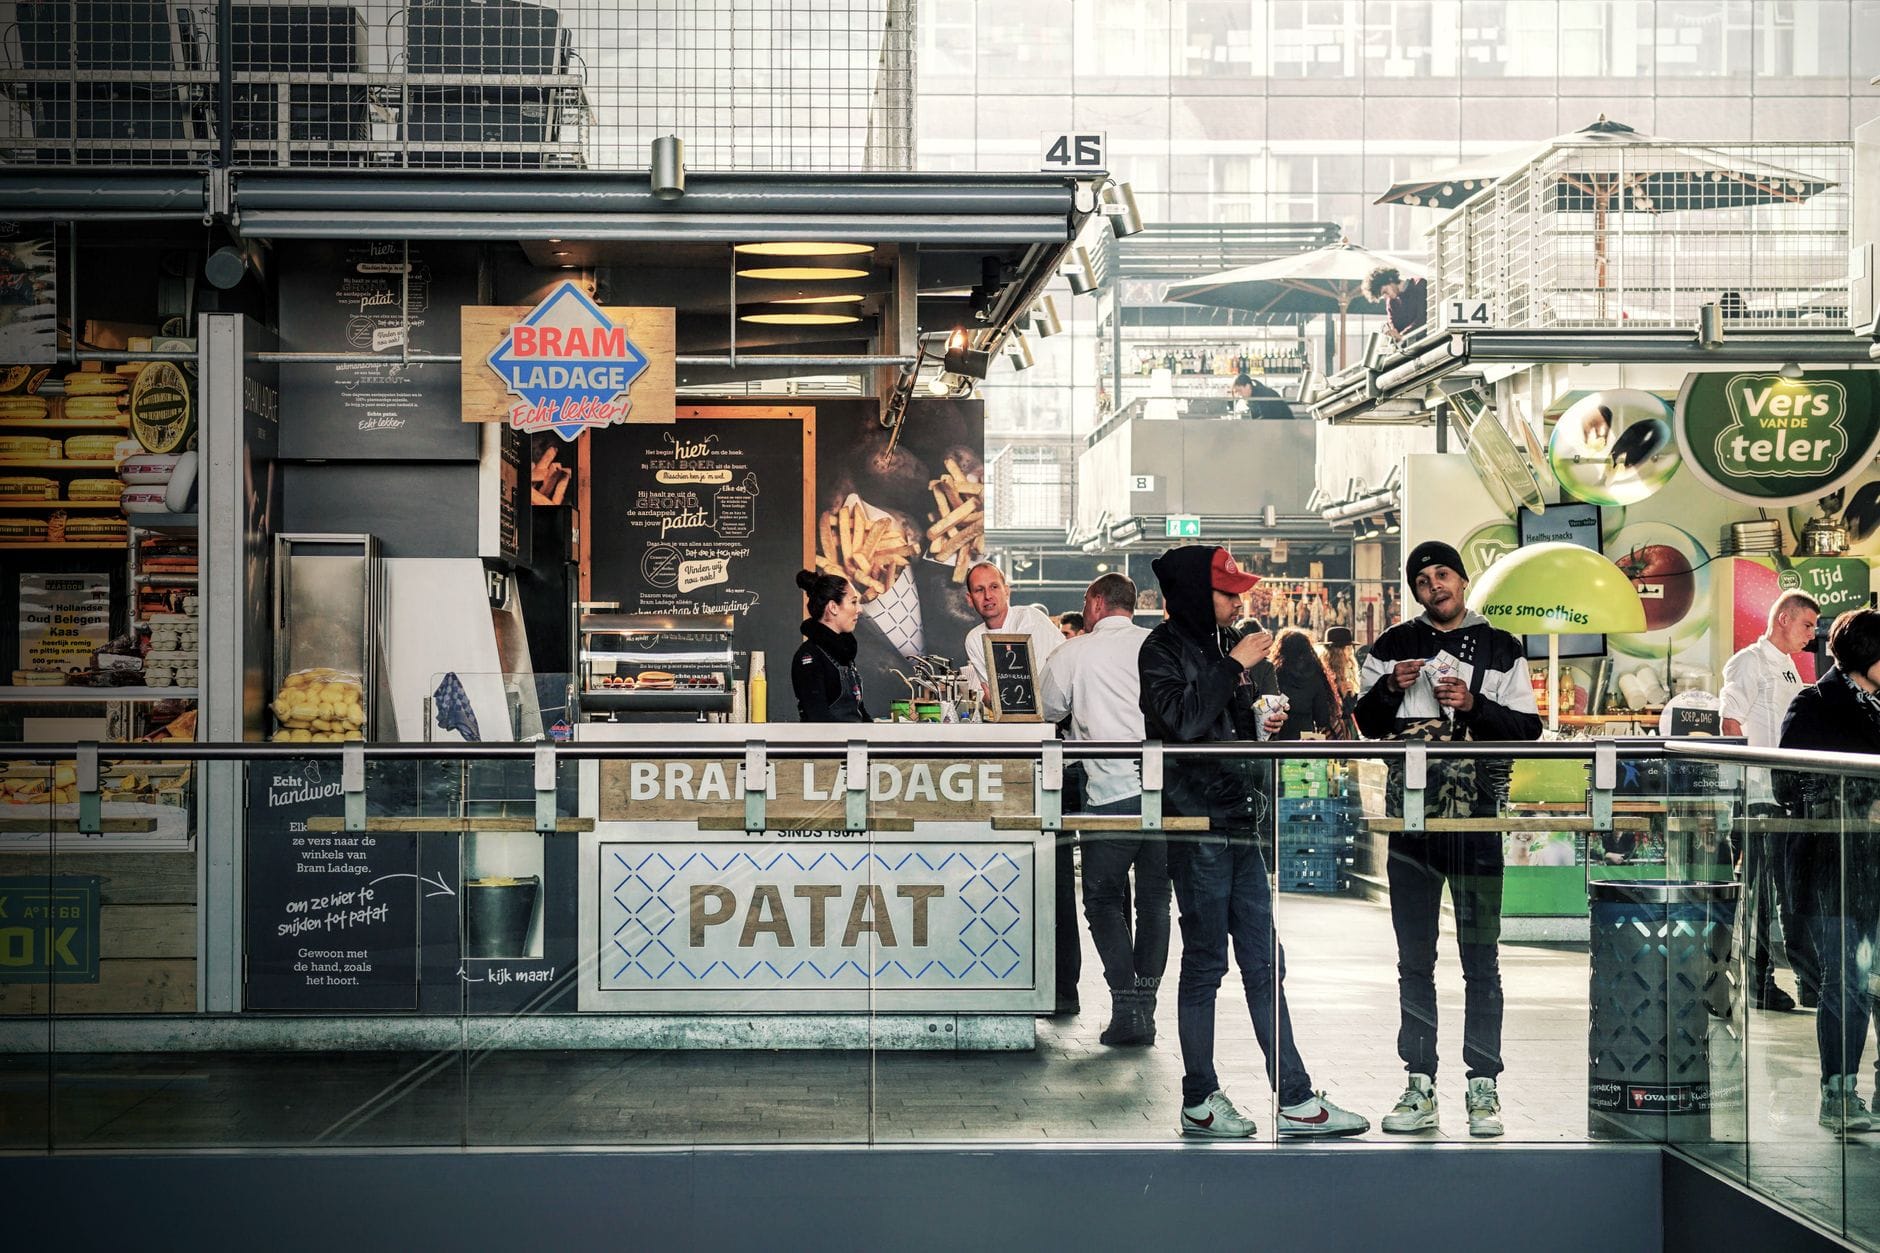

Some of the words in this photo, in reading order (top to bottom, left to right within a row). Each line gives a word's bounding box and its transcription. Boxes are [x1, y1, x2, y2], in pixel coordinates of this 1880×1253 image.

[1046, 135, 1101, 165] 46
[370, 241, 397, 256] hier
[360, 289, 395, 313] patat
[1450, 302, 1489, 324] 14
[513, 327, 626, 358] BRAM
[512, 366, 625, 390] LADAGE
[1743, 387, 1830, 417] Vers
[511, 396, 561, 427] Echt
[560, 395, 629, 422] lekker!
[358, 418, 377, 430] Echt
[378, 417, 406, 428] lekker!
[1759, 418, 1789, 429] VAN
[1790, 418, 1808, 428] DE
[674, 440, 710, 460] hier
[1730, 429, 1831, 463] teler
[649, 460, 675, 470] EEN
[679, 460, 715, 470] BOER
[635, 496, 700, 509] GROND
[638, 491, 648, 499] Hij
[638, 509, 676, 517] aardappels
[644, 519, 661, 528] jouw
[661, 506, 709, 539] patat
[1526, 533, 1551, 542] Healthy
[1551, 532, 1573, 541] snacks
[684, 563, 711, 575] Vinden
[700, 571, 716, 582] ook!
[1808, 564, 1843, 590] Tijd
[702, 600, 750, 616] toewijding
[1516, 604, 1589, 625] smoothies
[27, 615, 51, 624] Oud
[54, 615, 102, 625] Belegen
[50, 627, 79, 636] Kaas
[1005, 651, 1024, 670] 2
[1681, 710, 1697, 722] SOEP
[1700, 712, 1713, 724] DAG
[272, 776, 302, 787] Echt
[268, 775, 345, 807] handwer
[292, 838, 305, 846] ze
[307, 838, 331, 846] vers
[334, 838, 359, 846] naar
[361, 836, 376, 846] de
[301, 850, 344, 860] winkels
[346, 851, 367, 860] van
[297, 863, 326, 873] Bram
[327, 863, 372, 875] Ladage.
[286, 901, 308, 914] om
[310, 897, 329, 911] ze
[330, 890, 355, 907] hier
[357, 886, 375, 907] te
[278, 916, 322, 937] snijden
[324, 910, 348, 932] tot
[349, 903, 390, 928] patat
[689, 884, 945, 948] PATAT
[298, 948, 344, 959] Gewoon
[346, 949, 368, 959] met
[293, 961, 309, 972] de
[310, 961, 342, 973] hand,
[344, 961, 372, 972] zoals
[306, 975, 324, 986] het
[327, 975, 360, 986] hoort.
[488, 968, 513, 986] kijk
[515, 967, 556, 982] maar!
